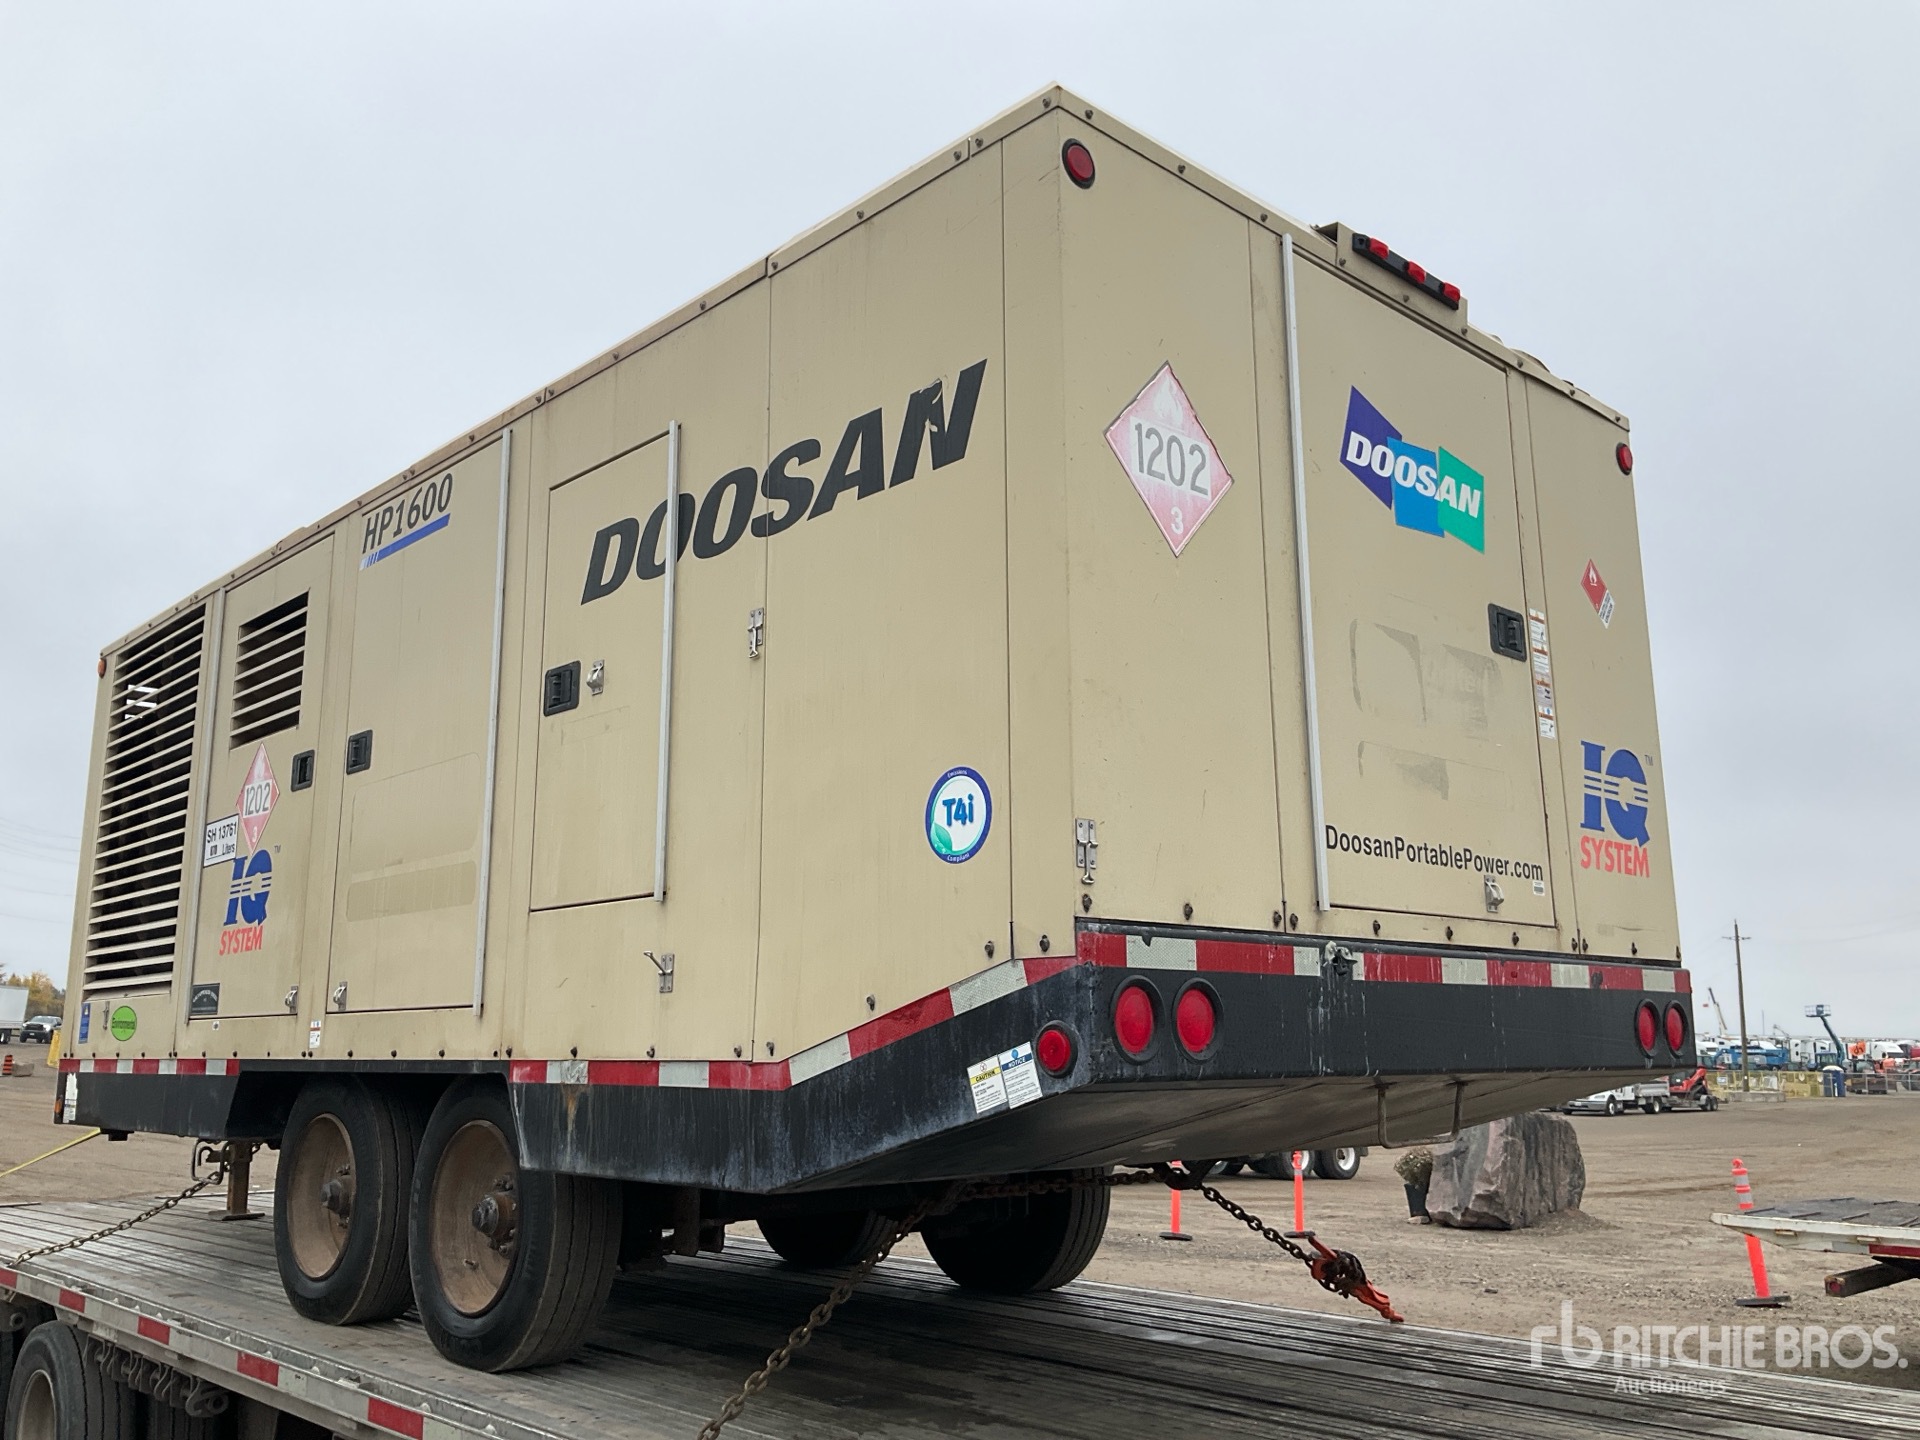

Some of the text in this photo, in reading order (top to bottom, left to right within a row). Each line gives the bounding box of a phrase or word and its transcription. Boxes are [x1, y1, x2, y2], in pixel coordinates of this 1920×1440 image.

[1134, 422, 1209, 496] 1202
[1346, 431, 1481, 518] DOOSAN
[580, 358, 988, 606] DOOSAN
[362, 473, 453, 554] HP1600
[1170, 506, 1184, 534] 3
[244, 781, 271, 816] 1202
[942, 793, 974, 827] T4i
[1579, 740, 1651, 847] IQ
[207, 828, 217, 843] SH
[252, 826, 258, 842] 3
[1325, 824, 1543, 881] DoosanPortablePower.com
[1580, 834, 1650, 878] SYSTEM
[223, 849, 272, 926] IQ
[219, 926, 263, 956] SYSTEM
[975, 1070, 997, 1082] CAUTION
[1008, 1056, 1026, 1069] NOTICE
